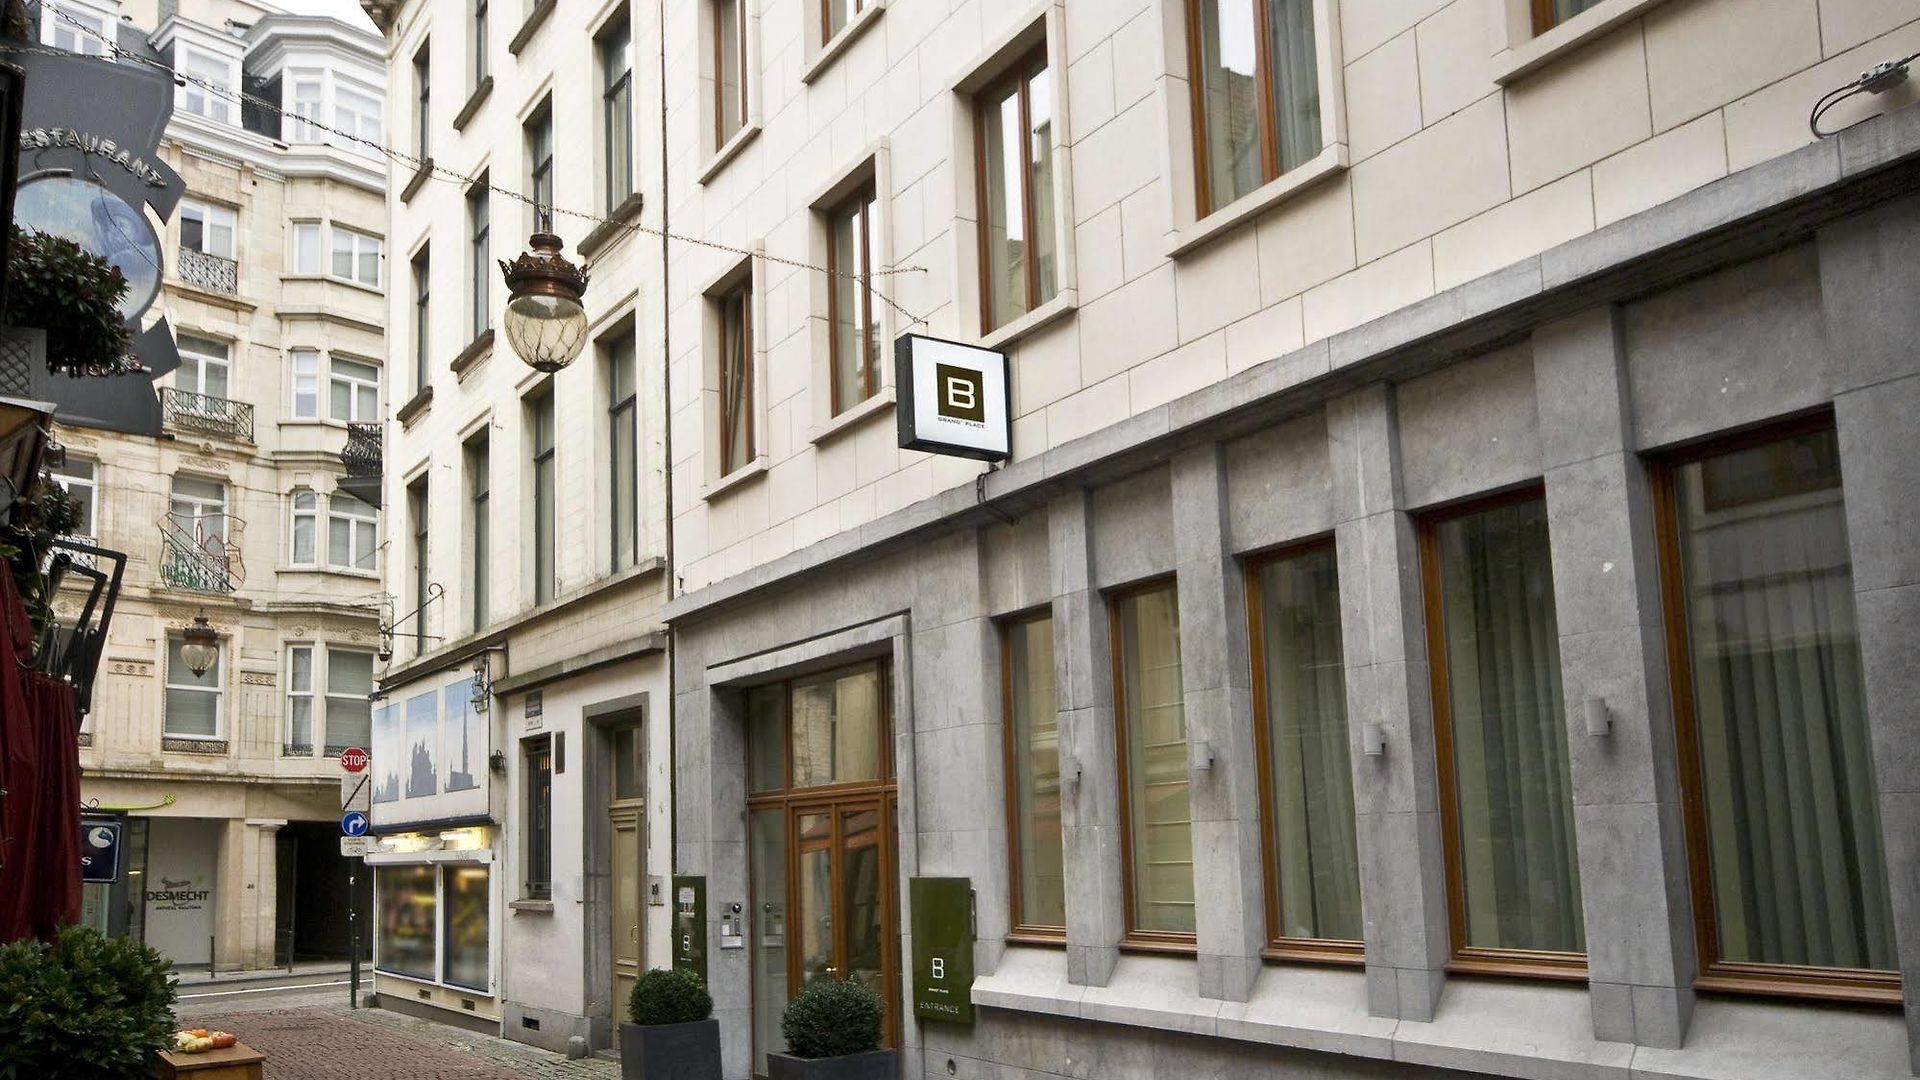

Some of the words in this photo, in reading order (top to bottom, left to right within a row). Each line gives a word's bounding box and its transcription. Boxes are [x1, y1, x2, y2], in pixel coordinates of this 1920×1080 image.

[947, 376, 975, 409] B
[342, 754, 367, 766] STOP
[147, 890, 210, 902] DESMECHT
[932, 957, 944, 979] B
[920, 1002, 959, 1014] ENTRANCE
